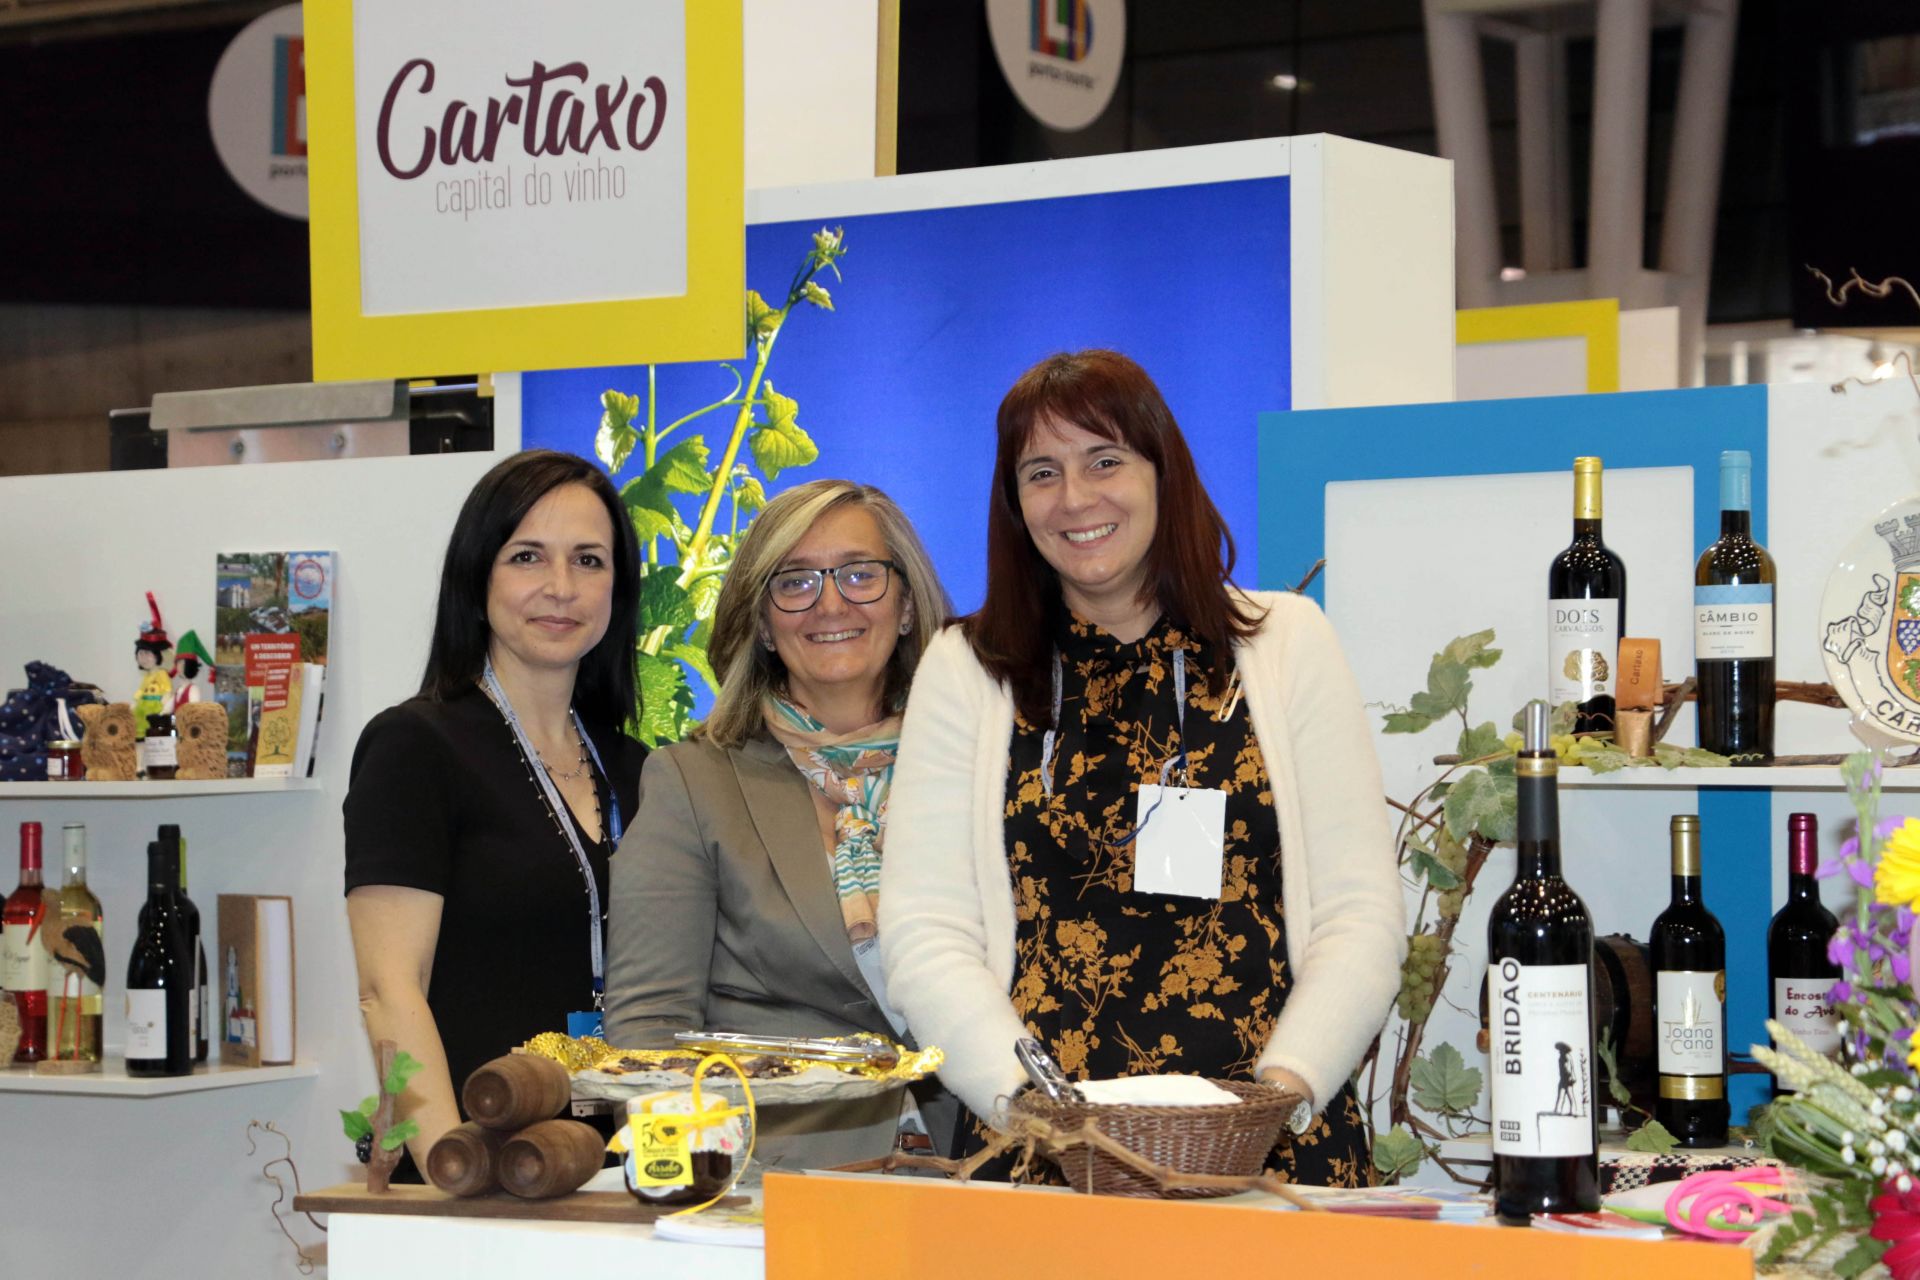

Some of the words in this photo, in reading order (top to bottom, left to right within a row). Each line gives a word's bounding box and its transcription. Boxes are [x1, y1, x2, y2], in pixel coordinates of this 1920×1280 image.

[377, 58, 667, 180] Cartaxo
[436, 163, 512, 222] capital
[524, 162, 552, 206] do
[564, 156, 626, 203] vinho
[1556, 609, 1600, 624] DOIS
[1699, 610, 1759, 623] CÂMBIO
[1631, 648, 1644, 685] Cartaxo
[1663, 1021, 1713, 1039] Joana
[1670, 1039, 1713, 1055] Cana
